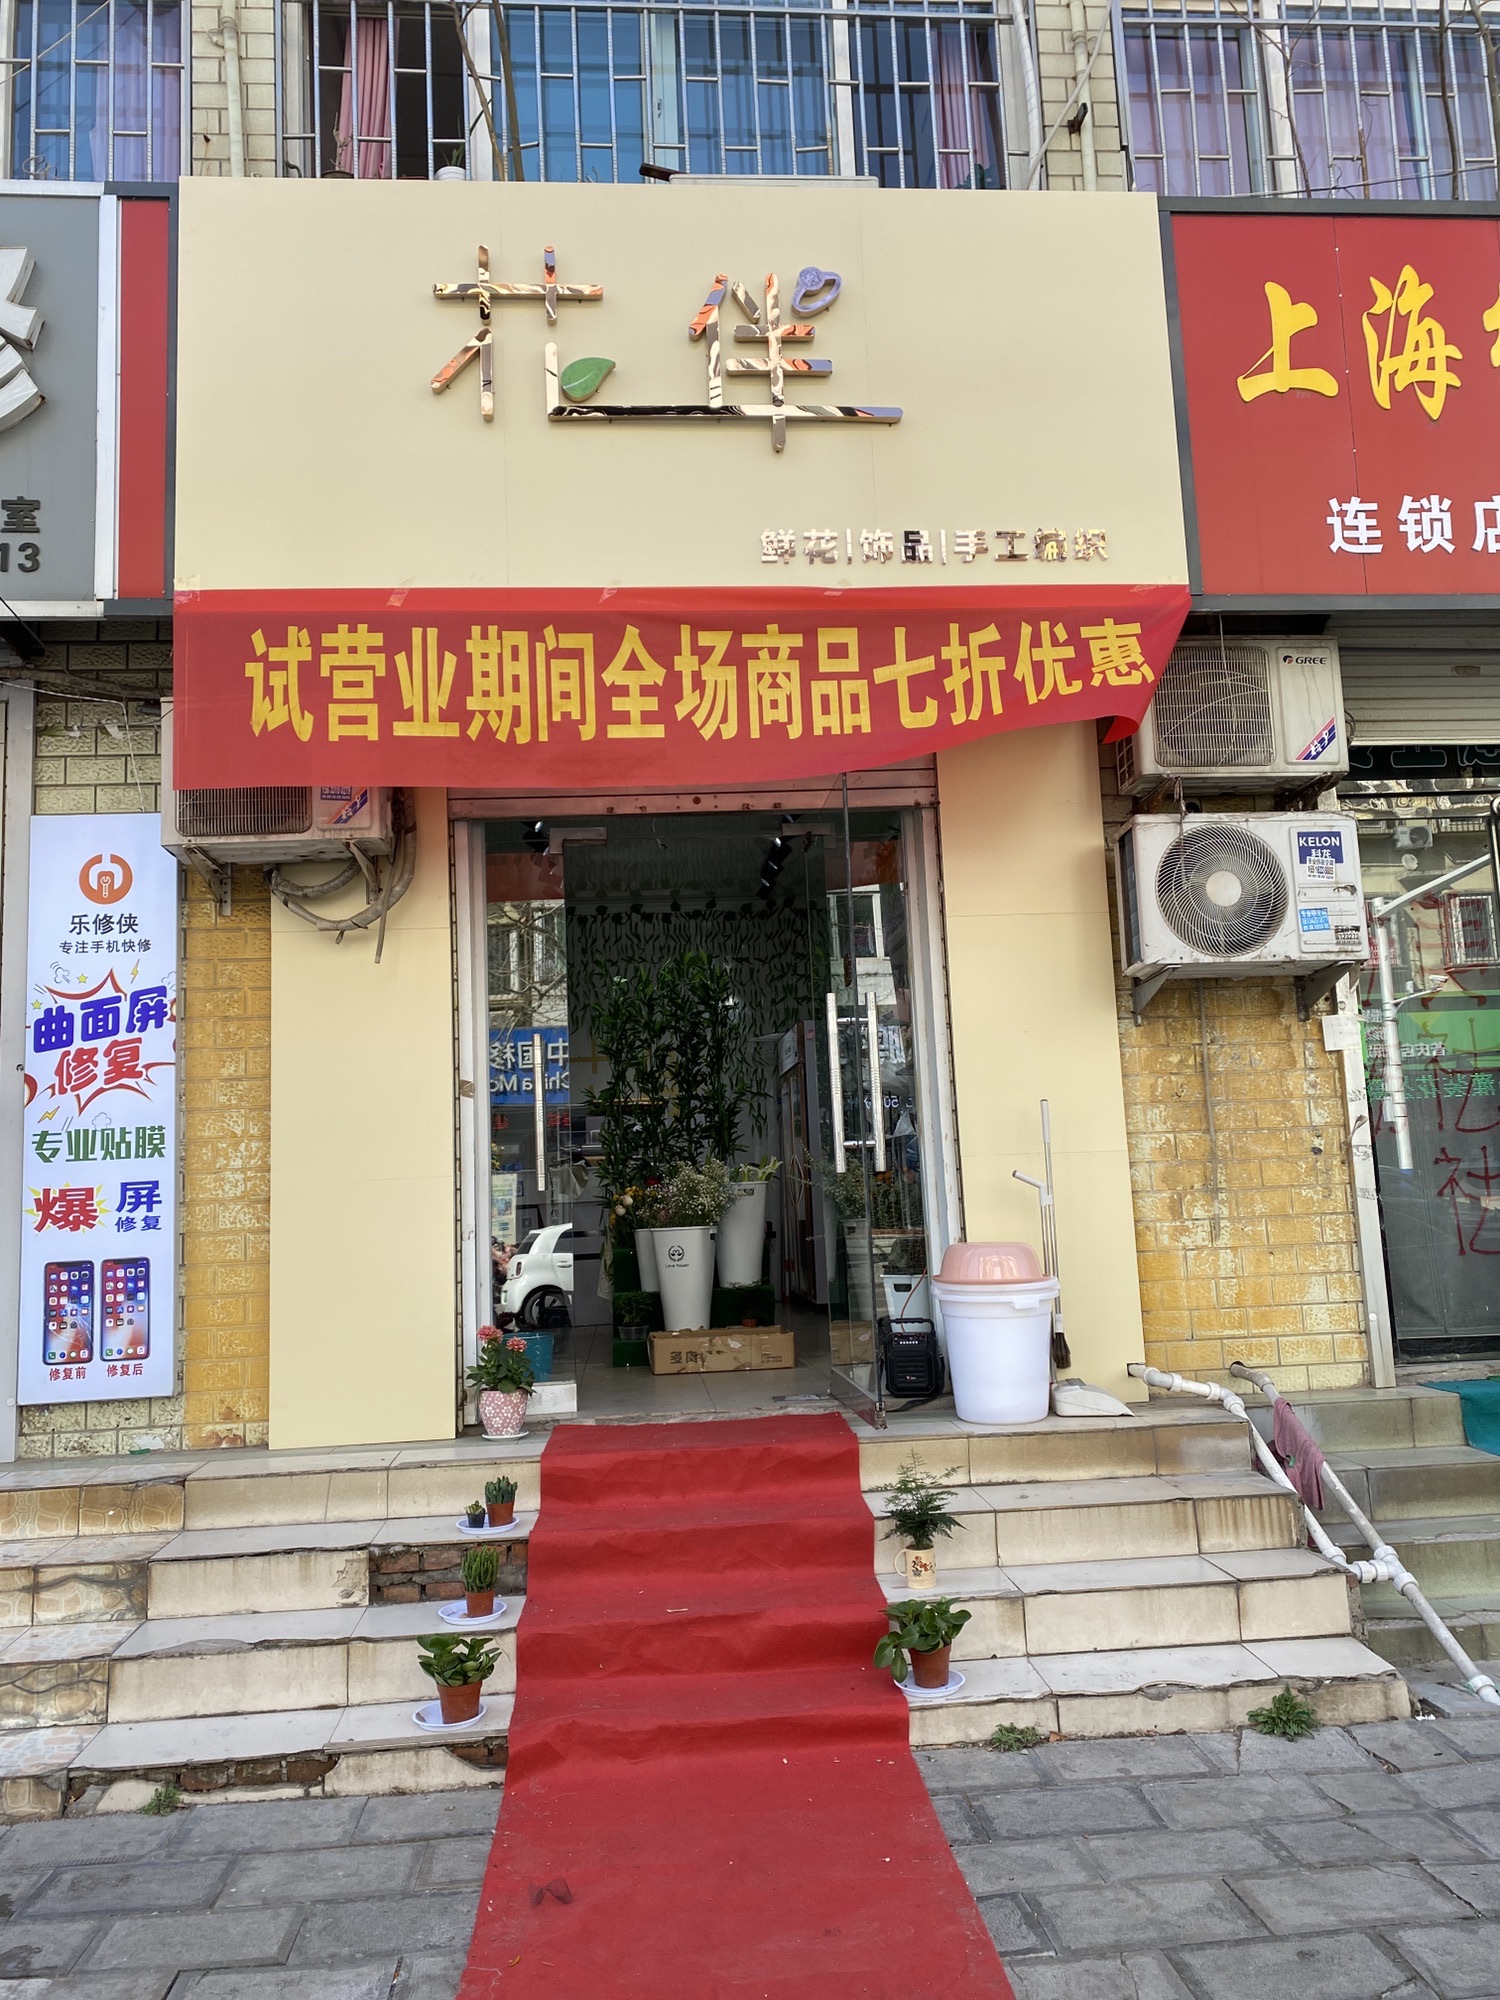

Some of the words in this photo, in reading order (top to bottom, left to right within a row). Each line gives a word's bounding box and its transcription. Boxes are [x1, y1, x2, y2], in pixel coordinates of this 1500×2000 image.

[1236, 263, 1500, 421] 上海
[1295, 655, 1327, 665] GREE
[244, 616, 1154, 744] 试营业期间全场商品七折优惠
[1299, 835, 1340, 848] KELON
[68, 913, 139, 935] 乐修侠
[58, 938, 152, 954] 专注手机快修
[33, 985, 169, 1054] 曲面屏
[54, 1036, 144, 1096] 修复
[31, 1125, 167, 1163] 专业贴膜
[33, 1187, 99, 1233] 爆
[115, 1180, 162, 1214] 屏
[115, 1214, 162, 1233] 修复
[49, 1366, 87, 1382] 修复前
[106, 1363, 144, 1378] 修复后
